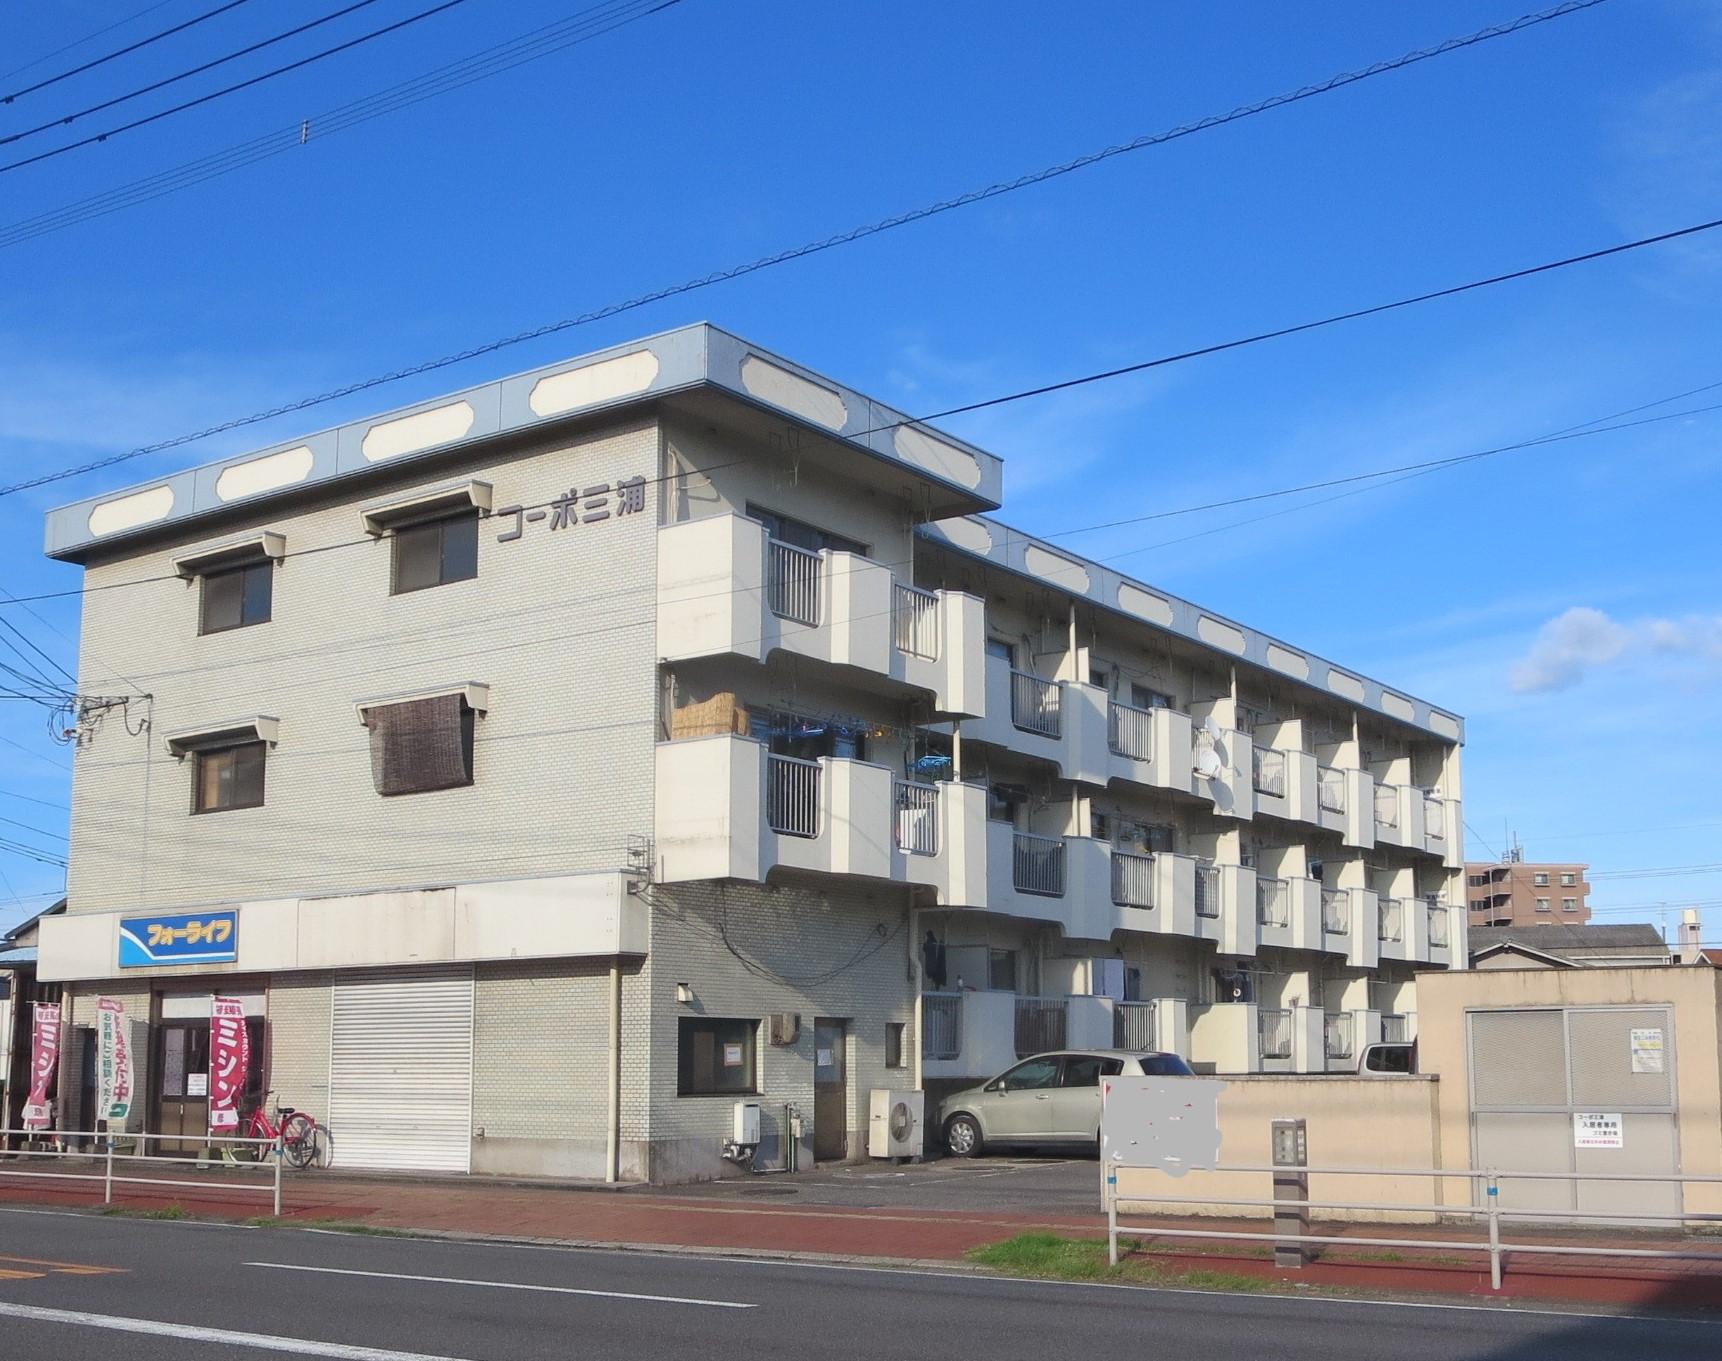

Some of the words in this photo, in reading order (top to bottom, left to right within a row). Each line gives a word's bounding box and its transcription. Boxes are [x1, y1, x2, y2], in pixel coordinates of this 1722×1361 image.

[497, 475, 646, 543] コーポ三浦
[147, 919, 233, 946] フォーライフ
[217, 1018, 238, 1107] ミシン
